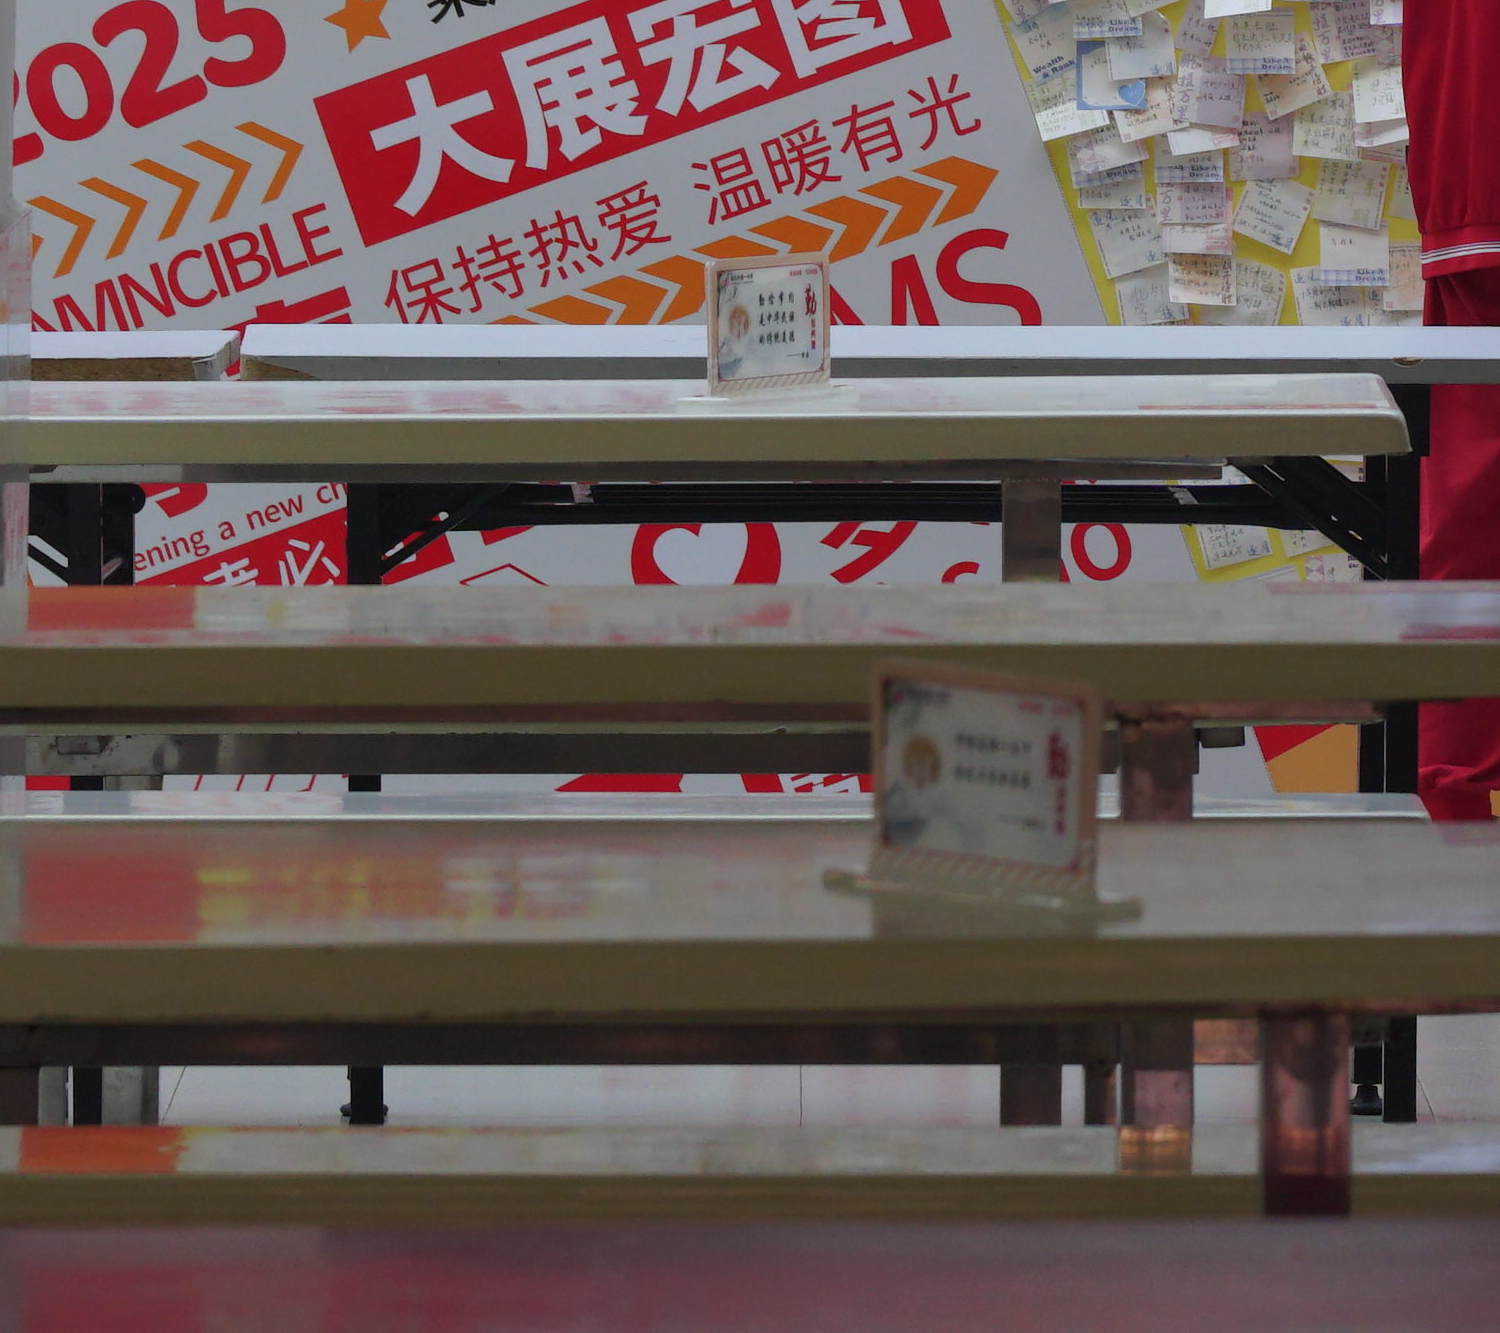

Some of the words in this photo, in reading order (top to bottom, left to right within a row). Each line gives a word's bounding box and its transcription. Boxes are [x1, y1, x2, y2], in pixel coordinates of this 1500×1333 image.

[385, 178, 676, 323] 保持热爱
[692, 72, 983, 226] 温暖有光
[134, 530, 210, 573] ening
[217, 521, 236, 540] a
[246, 493, 304, 530] new
